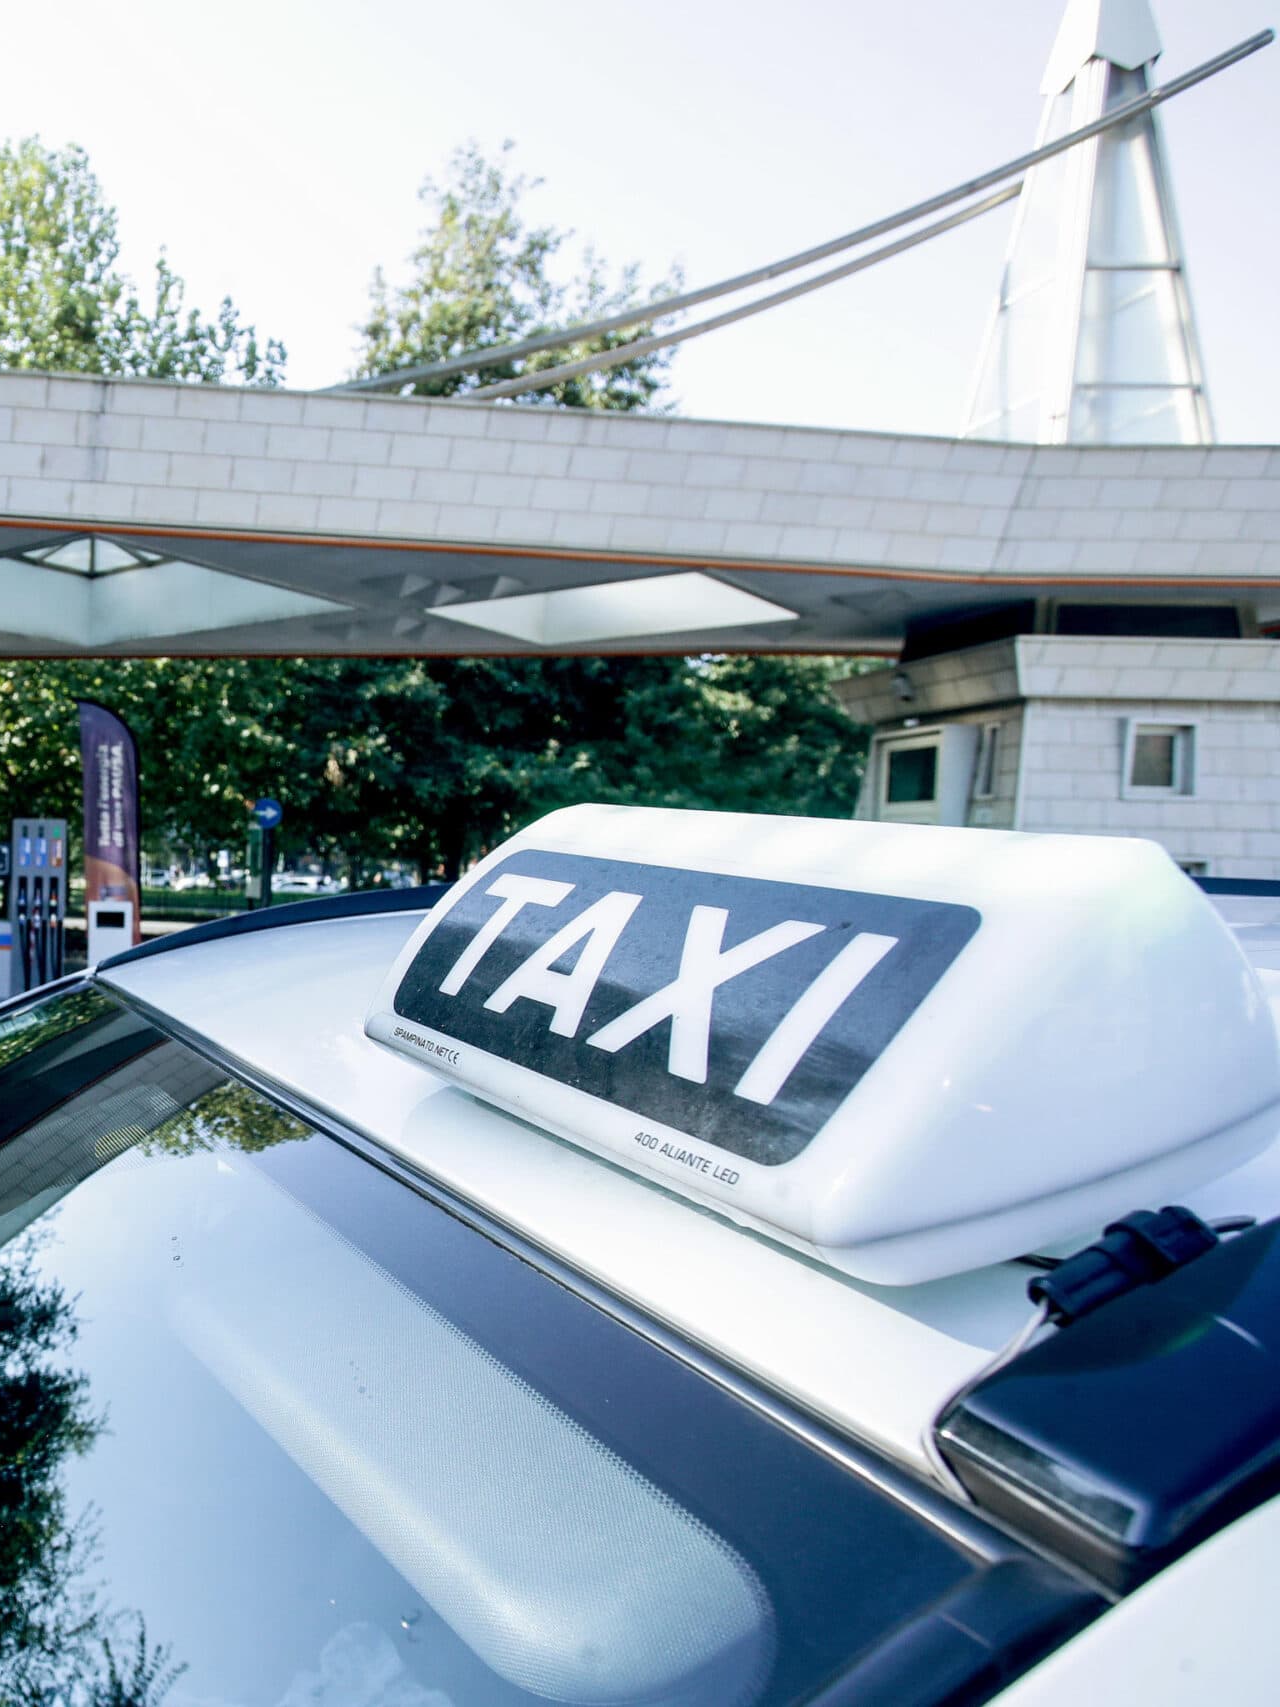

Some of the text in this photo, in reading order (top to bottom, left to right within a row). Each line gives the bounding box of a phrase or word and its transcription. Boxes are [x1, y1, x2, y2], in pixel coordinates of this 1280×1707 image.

[439, 873, 900, 1106] TAXI
[393, 1026, 450, 1058] SPAMPINATO.NET
[634, 1131, 740, 1186] 400 ALIANTE LED
